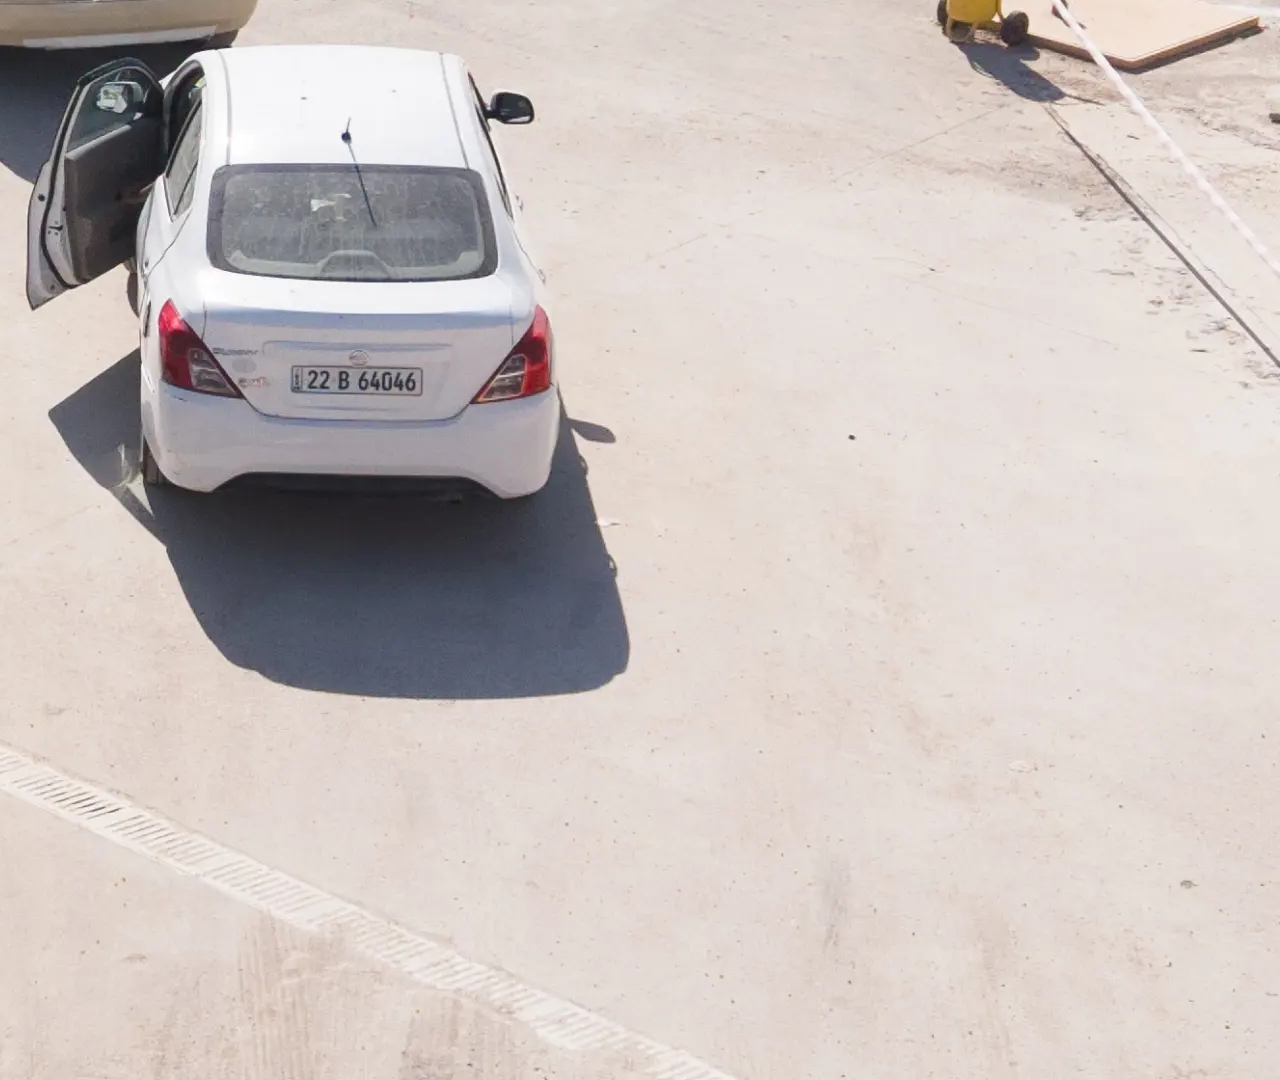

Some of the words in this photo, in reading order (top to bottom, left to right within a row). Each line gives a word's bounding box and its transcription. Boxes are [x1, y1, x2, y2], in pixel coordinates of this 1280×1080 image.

[307, 370, 330, 390] 22
[338, 370, 350, 390] B
[358, 371, 416, 392] 64046
